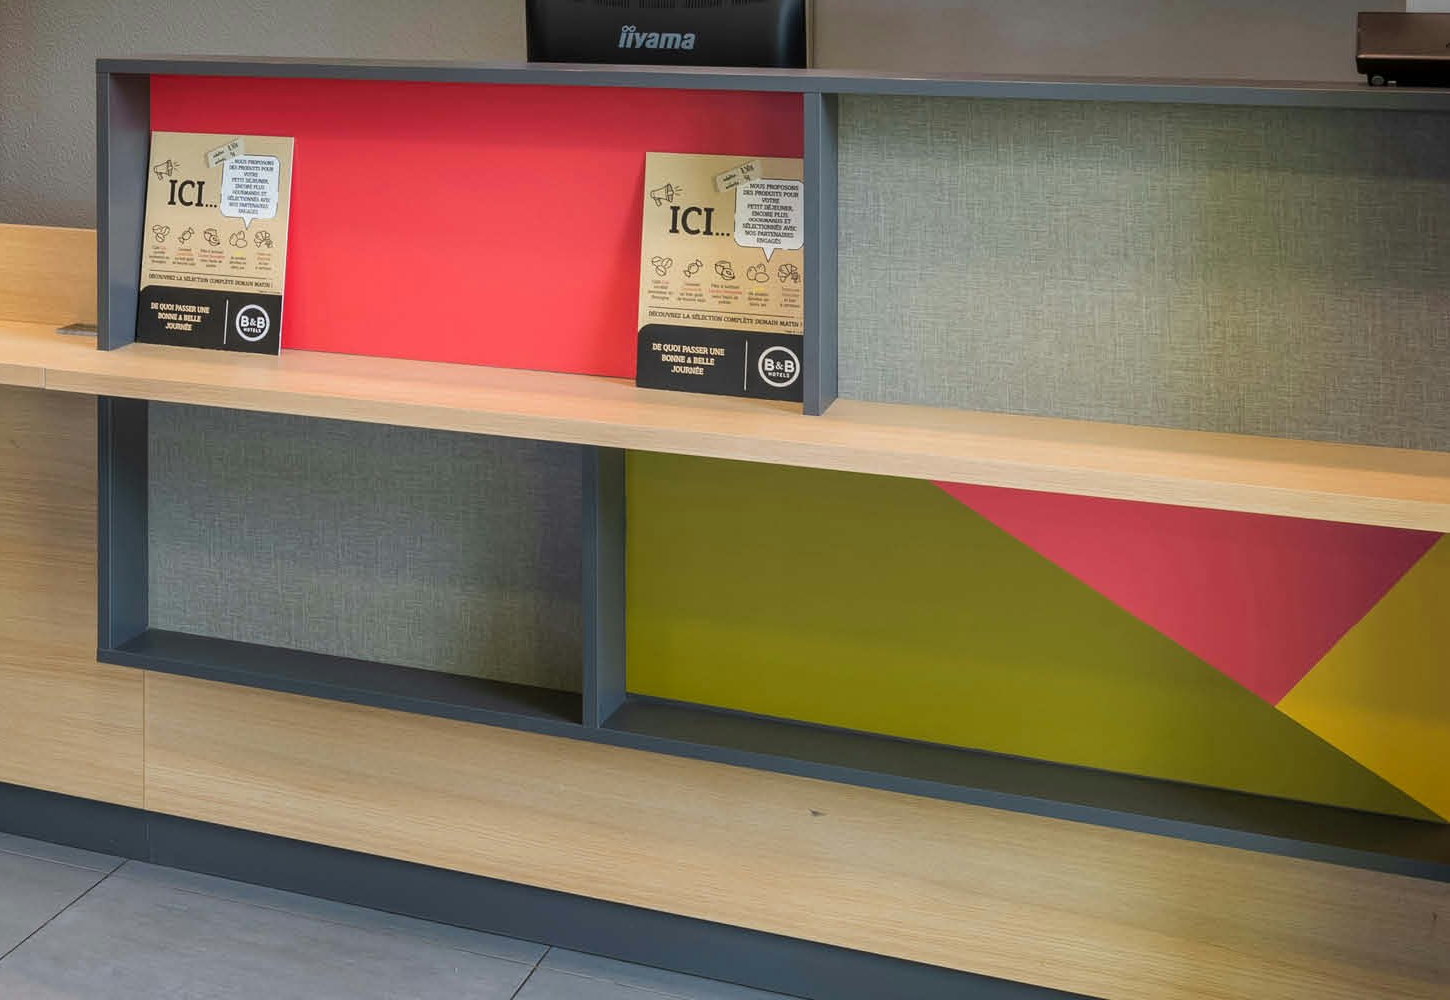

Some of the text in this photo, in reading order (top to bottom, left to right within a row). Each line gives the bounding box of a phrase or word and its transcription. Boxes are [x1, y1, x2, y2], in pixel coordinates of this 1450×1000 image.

[619, 25, 696, 50] iiyama
[167, 179, 218, 208] ICI...
[669, 205, 731, 237] ICI...
[235, 279, 253, 287] DEMAIN
[150, 301, 210, 314] DE QUOI PASSER UNE
[157, 312, 178, 321] BONNE
[183, 315, 202, 323] BELLE
[240, 315, 266, 329] B&B
[648, 310, 682, 319] DÉCOUVREZ
[691, 313, 723, 322] SÉLECTION
[165, 322, 193, 331] JOURNÉE
[652, 343, 725, 356] DE QUOI PASSER UNE
[661, 354, 686, 363] BONNE
[693, 356, 715, 366] BELLE
[764, 358, 795, 373] B&B
[670, 365, 704, 375] JOURNÉE
[767, 371, 790, 379] HOTELS
